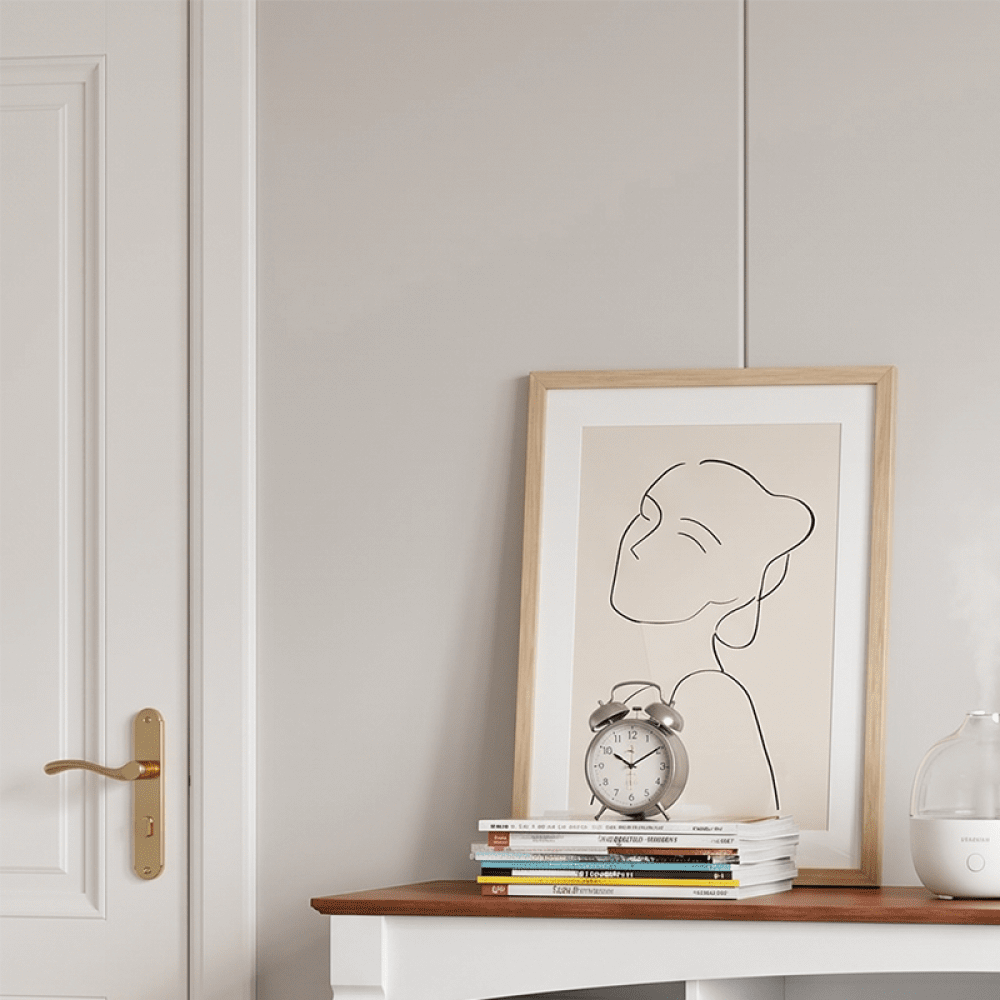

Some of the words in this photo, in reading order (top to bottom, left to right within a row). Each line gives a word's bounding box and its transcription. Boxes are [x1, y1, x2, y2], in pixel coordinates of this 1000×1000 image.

[614, 735, 621, 743] 11
[628, 731, 638, 740] 12
[603, 746, 613, 755] 10
[660, 763, 666, 771] 3
